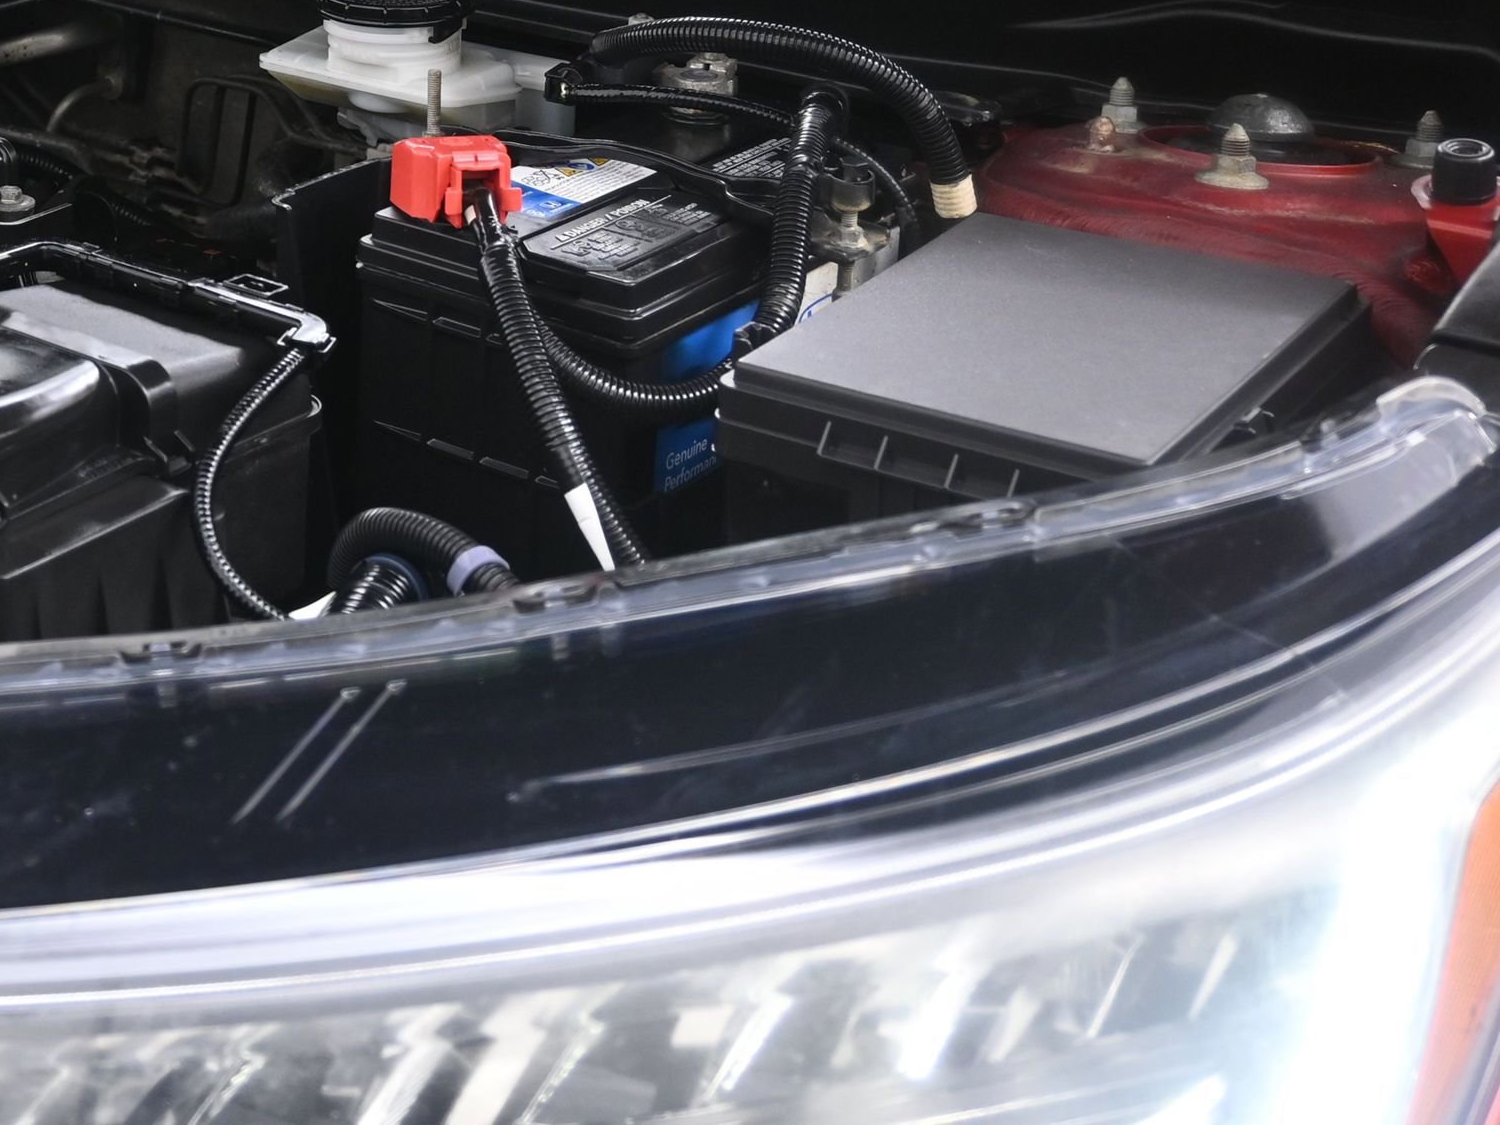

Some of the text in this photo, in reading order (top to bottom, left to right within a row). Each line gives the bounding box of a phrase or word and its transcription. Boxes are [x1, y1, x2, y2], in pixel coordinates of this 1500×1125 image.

[564, 217, 608, 237] DANGER
[665, 438, 708, 470] Genuine
[663, 455, 717, 493] Performan
